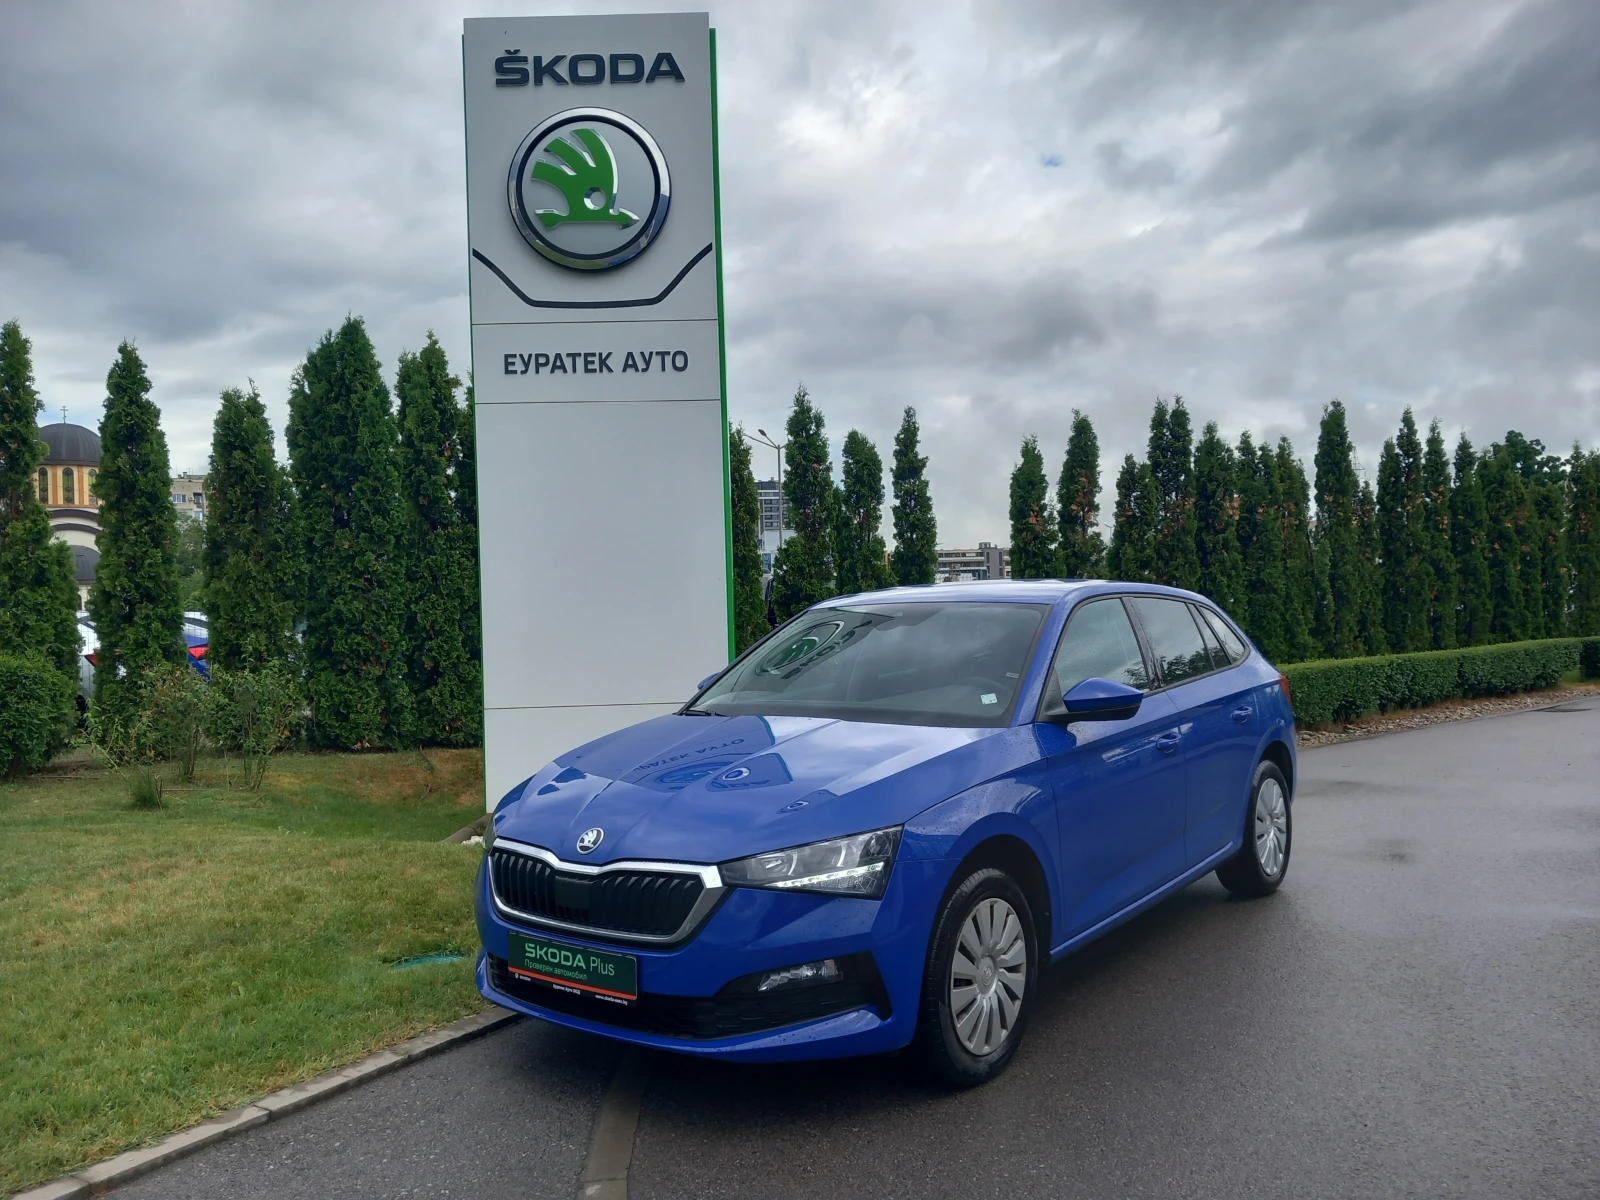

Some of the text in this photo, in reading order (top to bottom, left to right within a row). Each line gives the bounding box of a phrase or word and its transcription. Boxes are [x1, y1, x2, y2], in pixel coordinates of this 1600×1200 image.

[495, 49, 685, 87] ŠKODA
[504, 350, 689, 375] ЕУРАТЕК АУТО
[524, 959, 588, 981] Проверен автомобил
[590, 956, 615, 976] Plus
